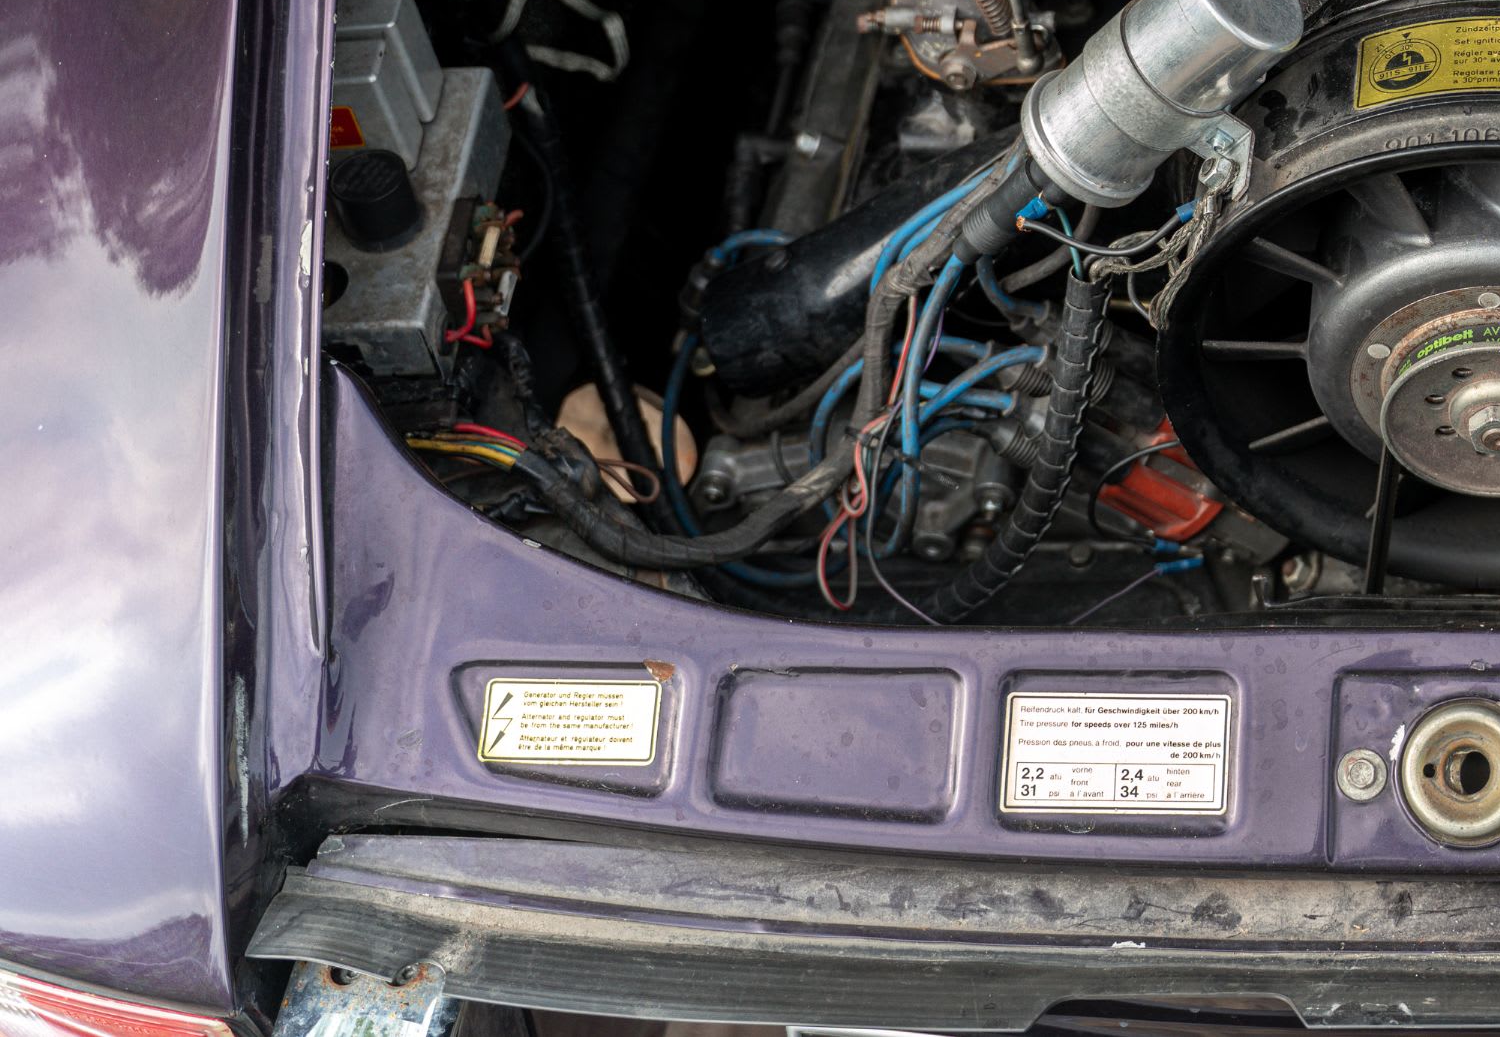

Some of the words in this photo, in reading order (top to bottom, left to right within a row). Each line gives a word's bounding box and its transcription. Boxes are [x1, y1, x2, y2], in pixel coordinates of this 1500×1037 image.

[1384, 50, 1396, 60] OT
[1454, 49, 1484, 58] Régler
[1453, 70, 1494, 78] Regolare
[1416, 328, 1474, 359] optibelt
[523, 691, 556, 699] Generator
[574, 692, 595, 700] Regler
[540, 700, 567, 708] gleichen
[1020, 706, 1064, 714] Reifendruck
[1097, 707, 1160, 716] Geschwindigkeit
[1020, 720, 1034, 728] Tire
[1084, 721, 1112, 729] speeds
[1021, 767, 1044, 782] 2,2
[1120, 768, 1144, 783] 2,4
[1020, 784, 1036, 796] 31
[1120, 786, 1139, 798] 34
